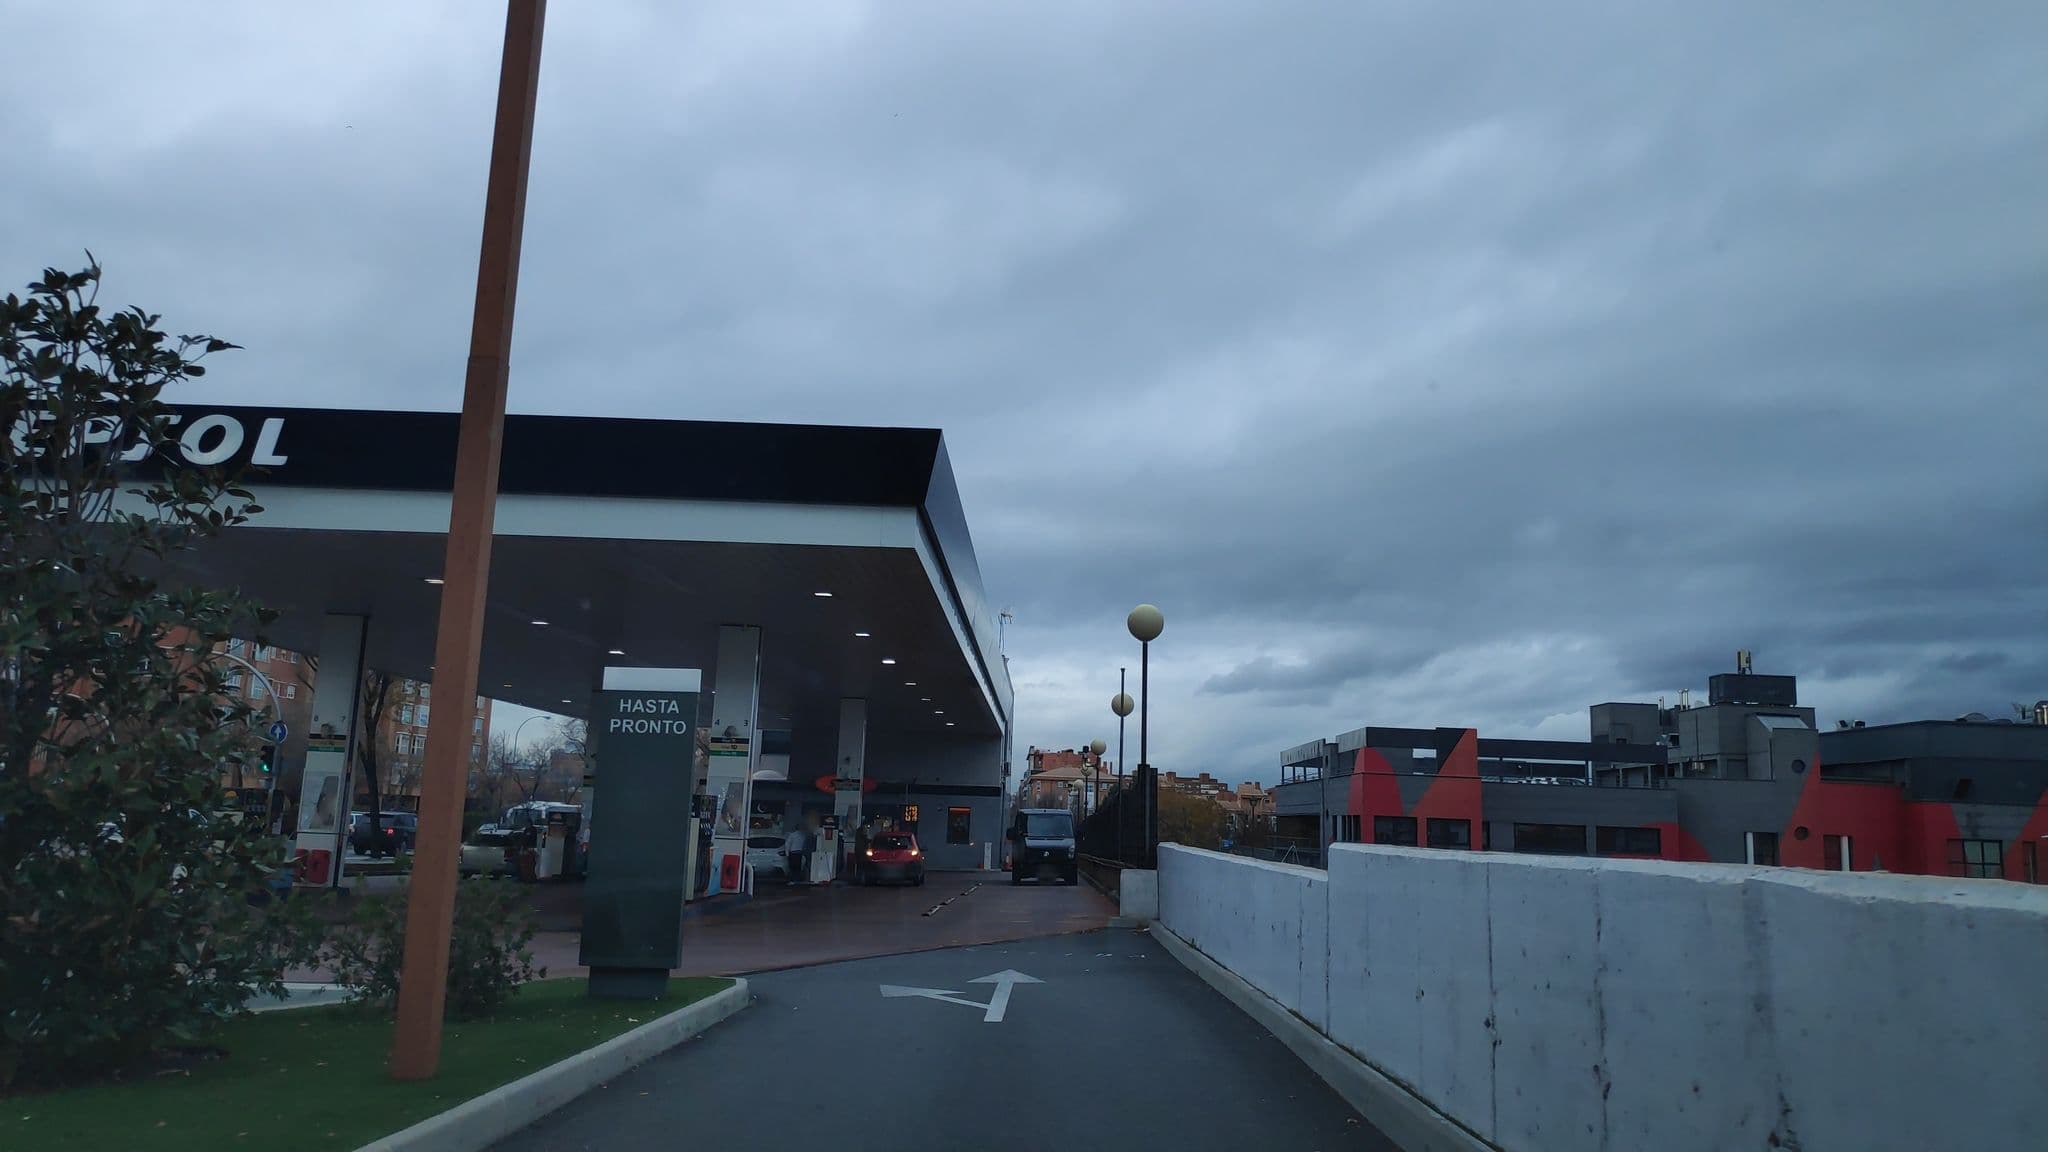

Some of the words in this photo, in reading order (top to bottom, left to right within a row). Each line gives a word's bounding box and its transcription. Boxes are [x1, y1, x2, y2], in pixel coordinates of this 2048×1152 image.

[619, 698, 680, 714] HASTA
[609, 718, 687, 735] PRONTO
[743, 719, 749, 727] 3
